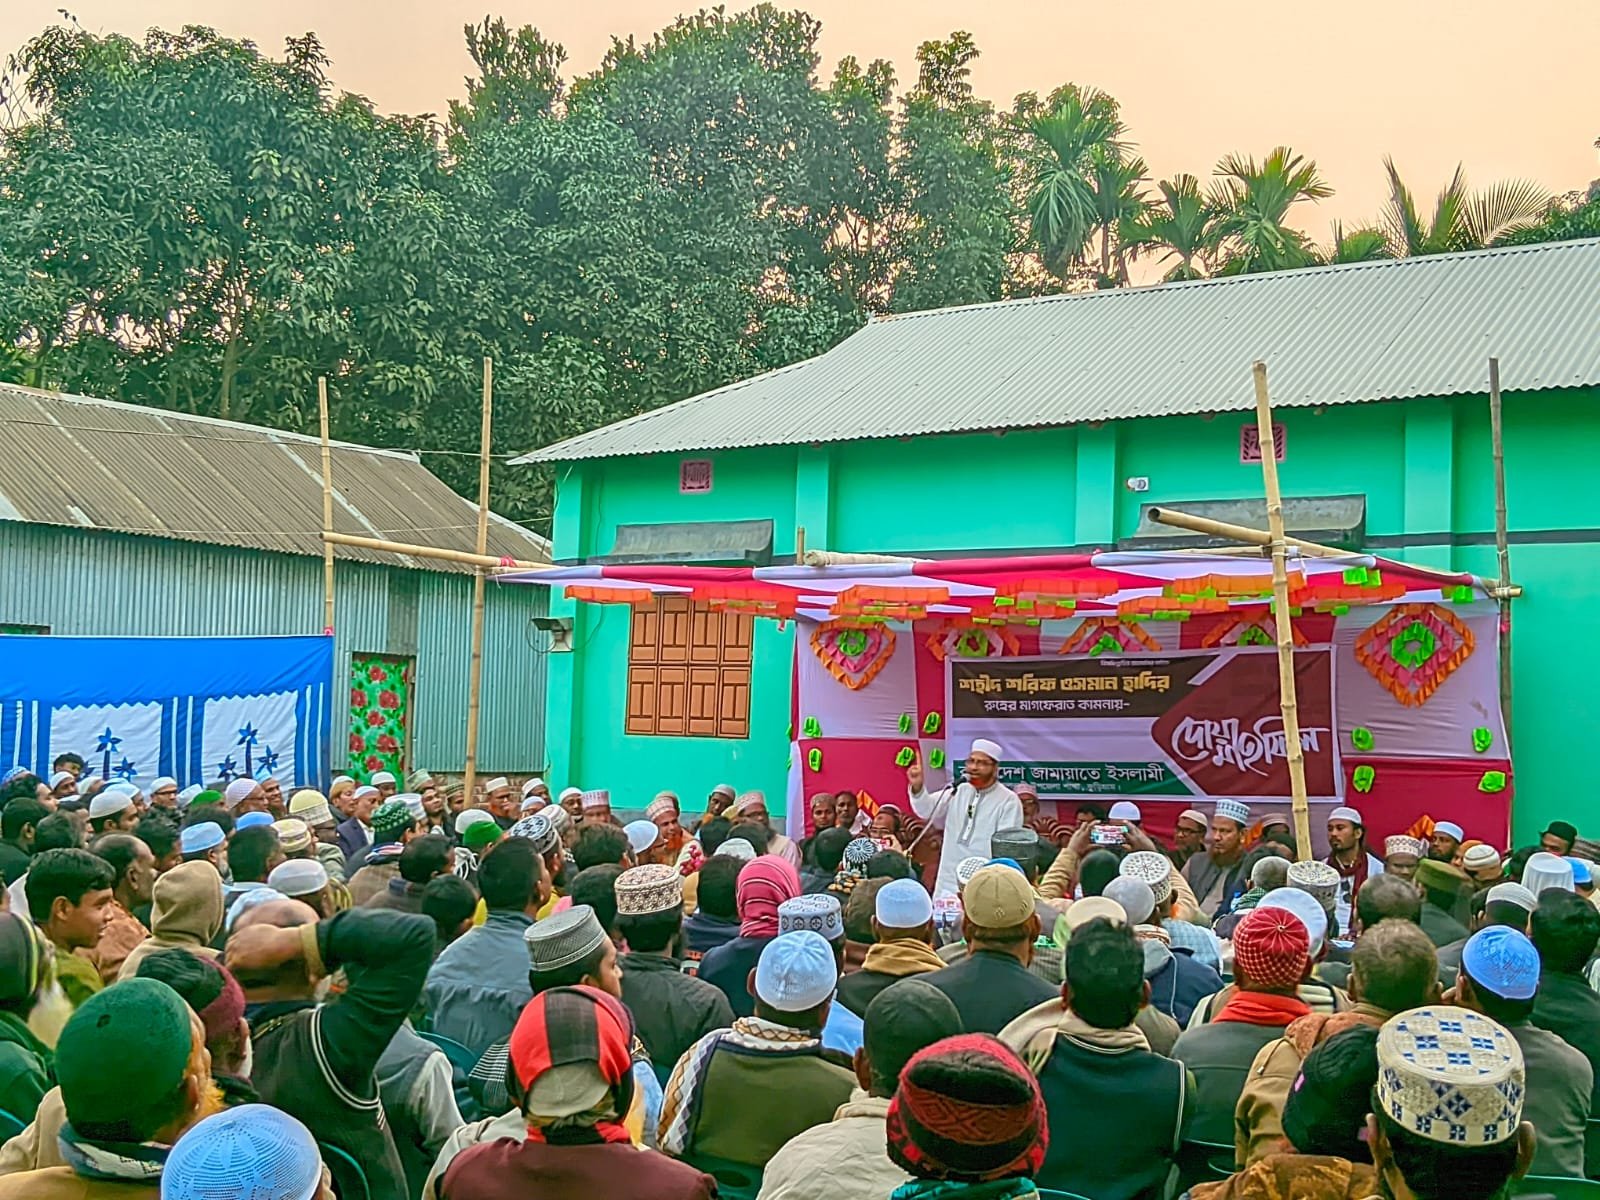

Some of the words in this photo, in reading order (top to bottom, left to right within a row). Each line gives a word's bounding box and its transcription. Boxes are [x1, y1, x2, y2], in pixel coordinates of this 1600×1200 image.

[959, 673, 1003, 694] শহীদ
[1006, 672, 1057, 694] শরিফ
[1060, 675, 1119, 691] ওসমান
[1122, 671, 1170, 693] হাদির
[984, 699, 1017, 712] রুহের
[1030, 765, 1101, 782] জামায়াতে
[1105, 762, 1165, 782] ইসলামী
